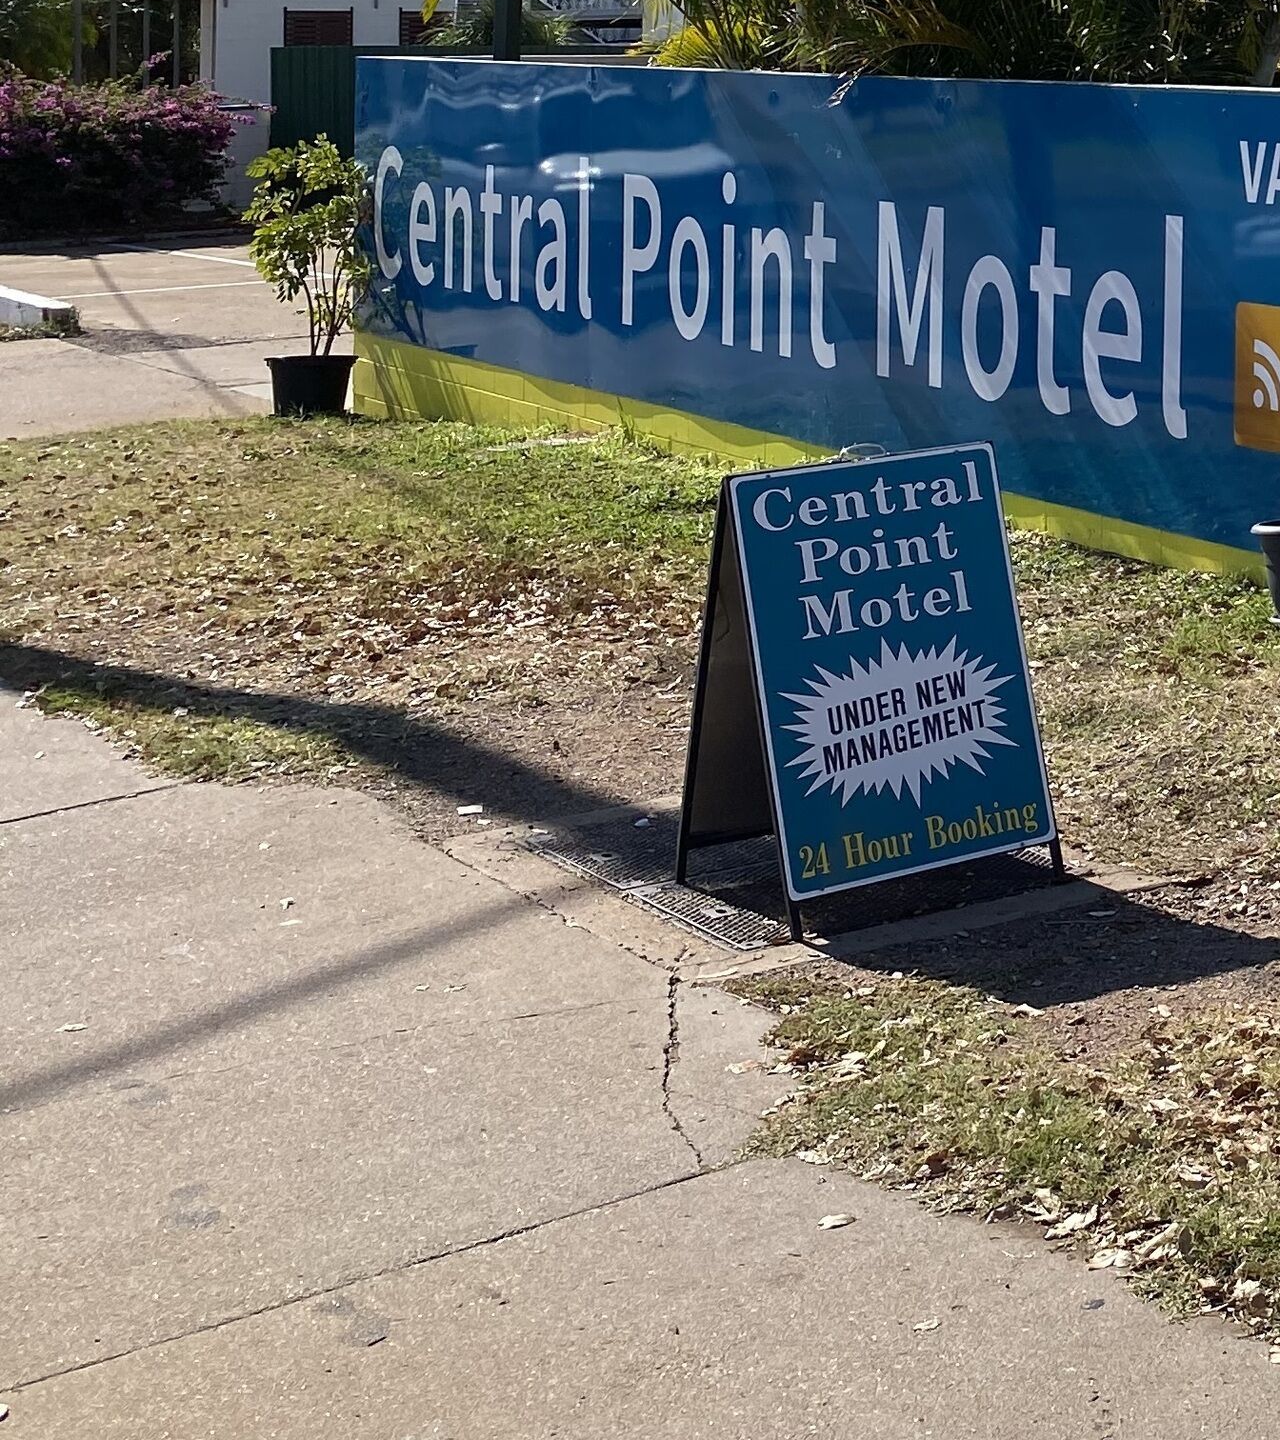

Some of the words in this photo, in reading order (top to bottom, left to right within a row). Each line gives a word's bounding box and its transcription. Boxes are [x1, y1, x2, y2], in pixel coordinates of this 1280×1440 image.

[373, 145, 593, 321] Central
[621, 171, 837, 369] Point
[875, 200, 1188, 440] Motel
[752, 460, 984, 532] Central
[794, 521, 959, 585] Point
[798, 570, 973, 640] Motel
[822, 698, 987, 776] MANAGEMENT
[827, 687, 907, 736] UNDER
[917, 669, 968, 708] NEW
[799, 841, 831, 880] 24
[842, 828, 914, 870] Hour
[925, 802, 1039, 850] Booking
